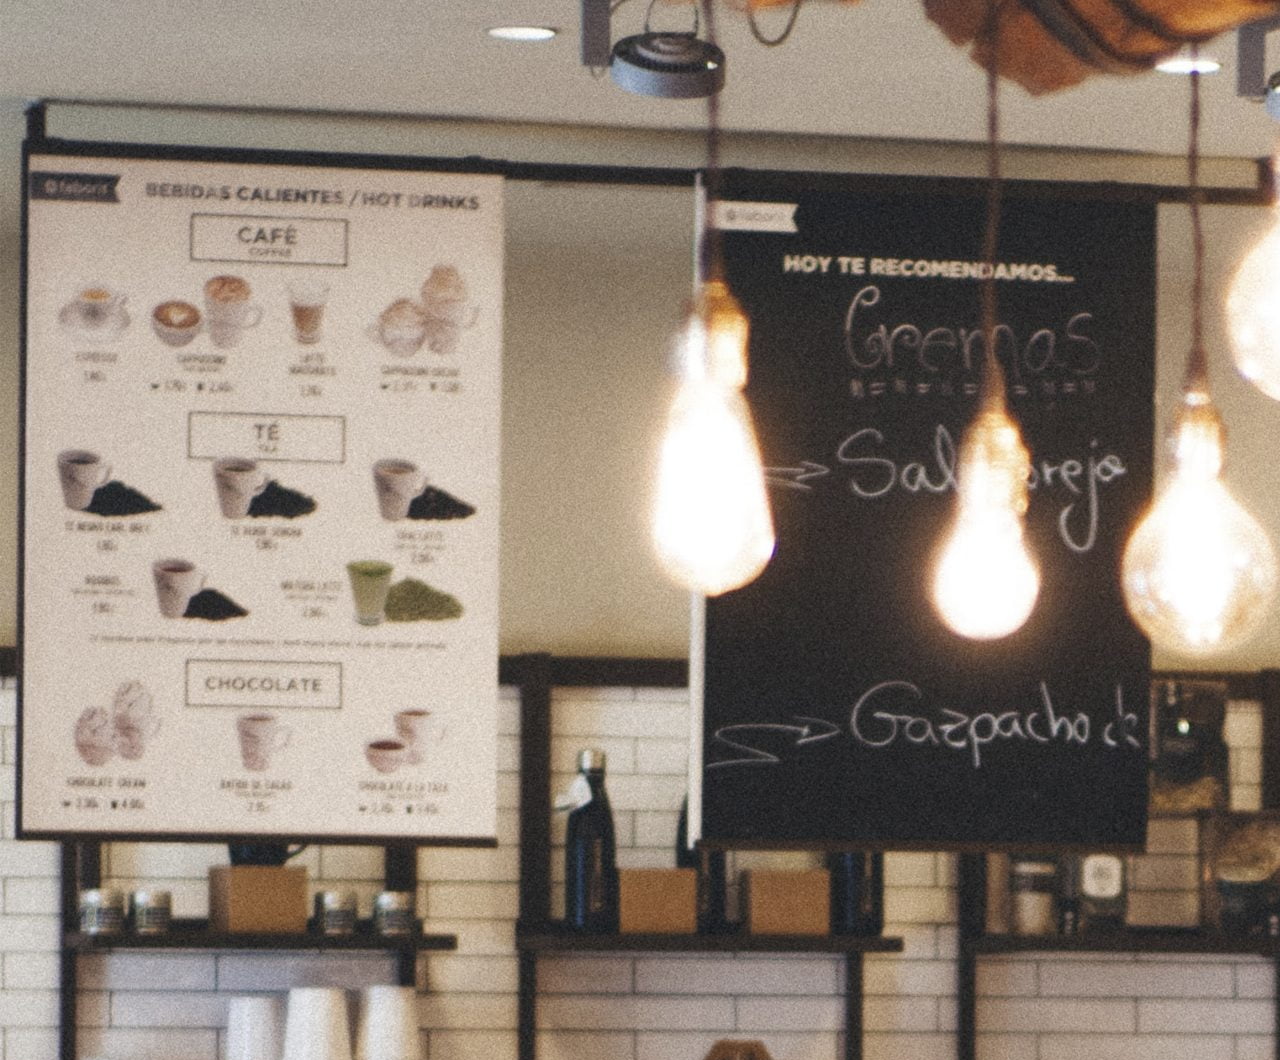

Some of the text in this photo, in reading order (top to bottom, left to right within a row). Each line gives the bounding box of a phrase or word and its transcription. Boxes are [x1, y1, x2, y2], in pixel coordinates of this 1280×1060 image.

[145, 182, 232, 200] BEBIDAS
[235, 185, 344, 204] CALIENTES
[408, 194, 480, 211] DRINKS
[237, 225, 299, 246] CAFÉ
[783, 254, 831, 274] HOY
[837, 256, 866, 276] TE
[253, 421, 280, 441] TÉ
[204, 675, 324, 694] CHOCOLATE
[852, 681, 1091, 768] Gazpacho
